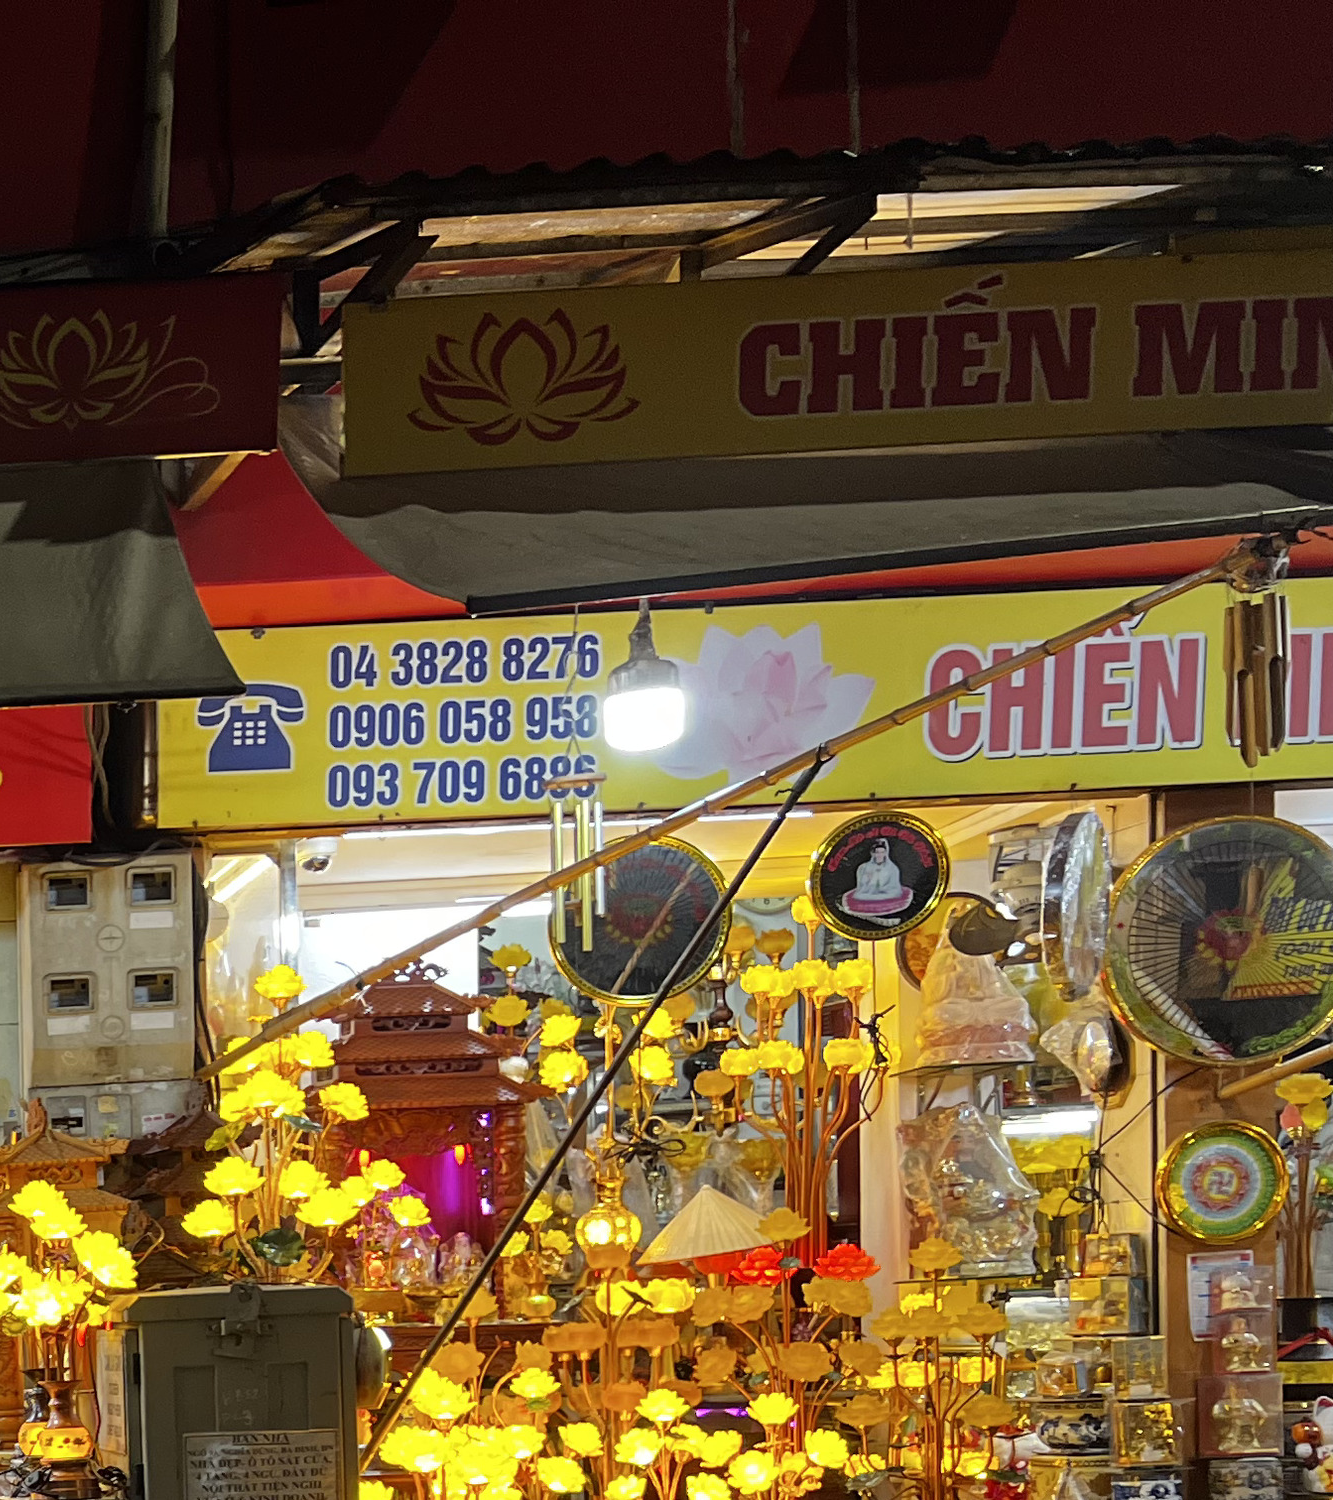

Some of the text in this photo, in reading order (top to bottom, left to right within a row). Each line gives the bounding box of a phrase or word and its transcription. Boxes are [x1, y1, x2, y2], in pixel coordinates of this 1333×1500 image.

[737, 272, 1098, 418] CHIẾN
[329, 633, 600, 689] 04 3828 8276
[329, 694, 598, 749] 0906 058 958
[328, 762, 399, 808] 093
[413, 759, 485, 805] 709
